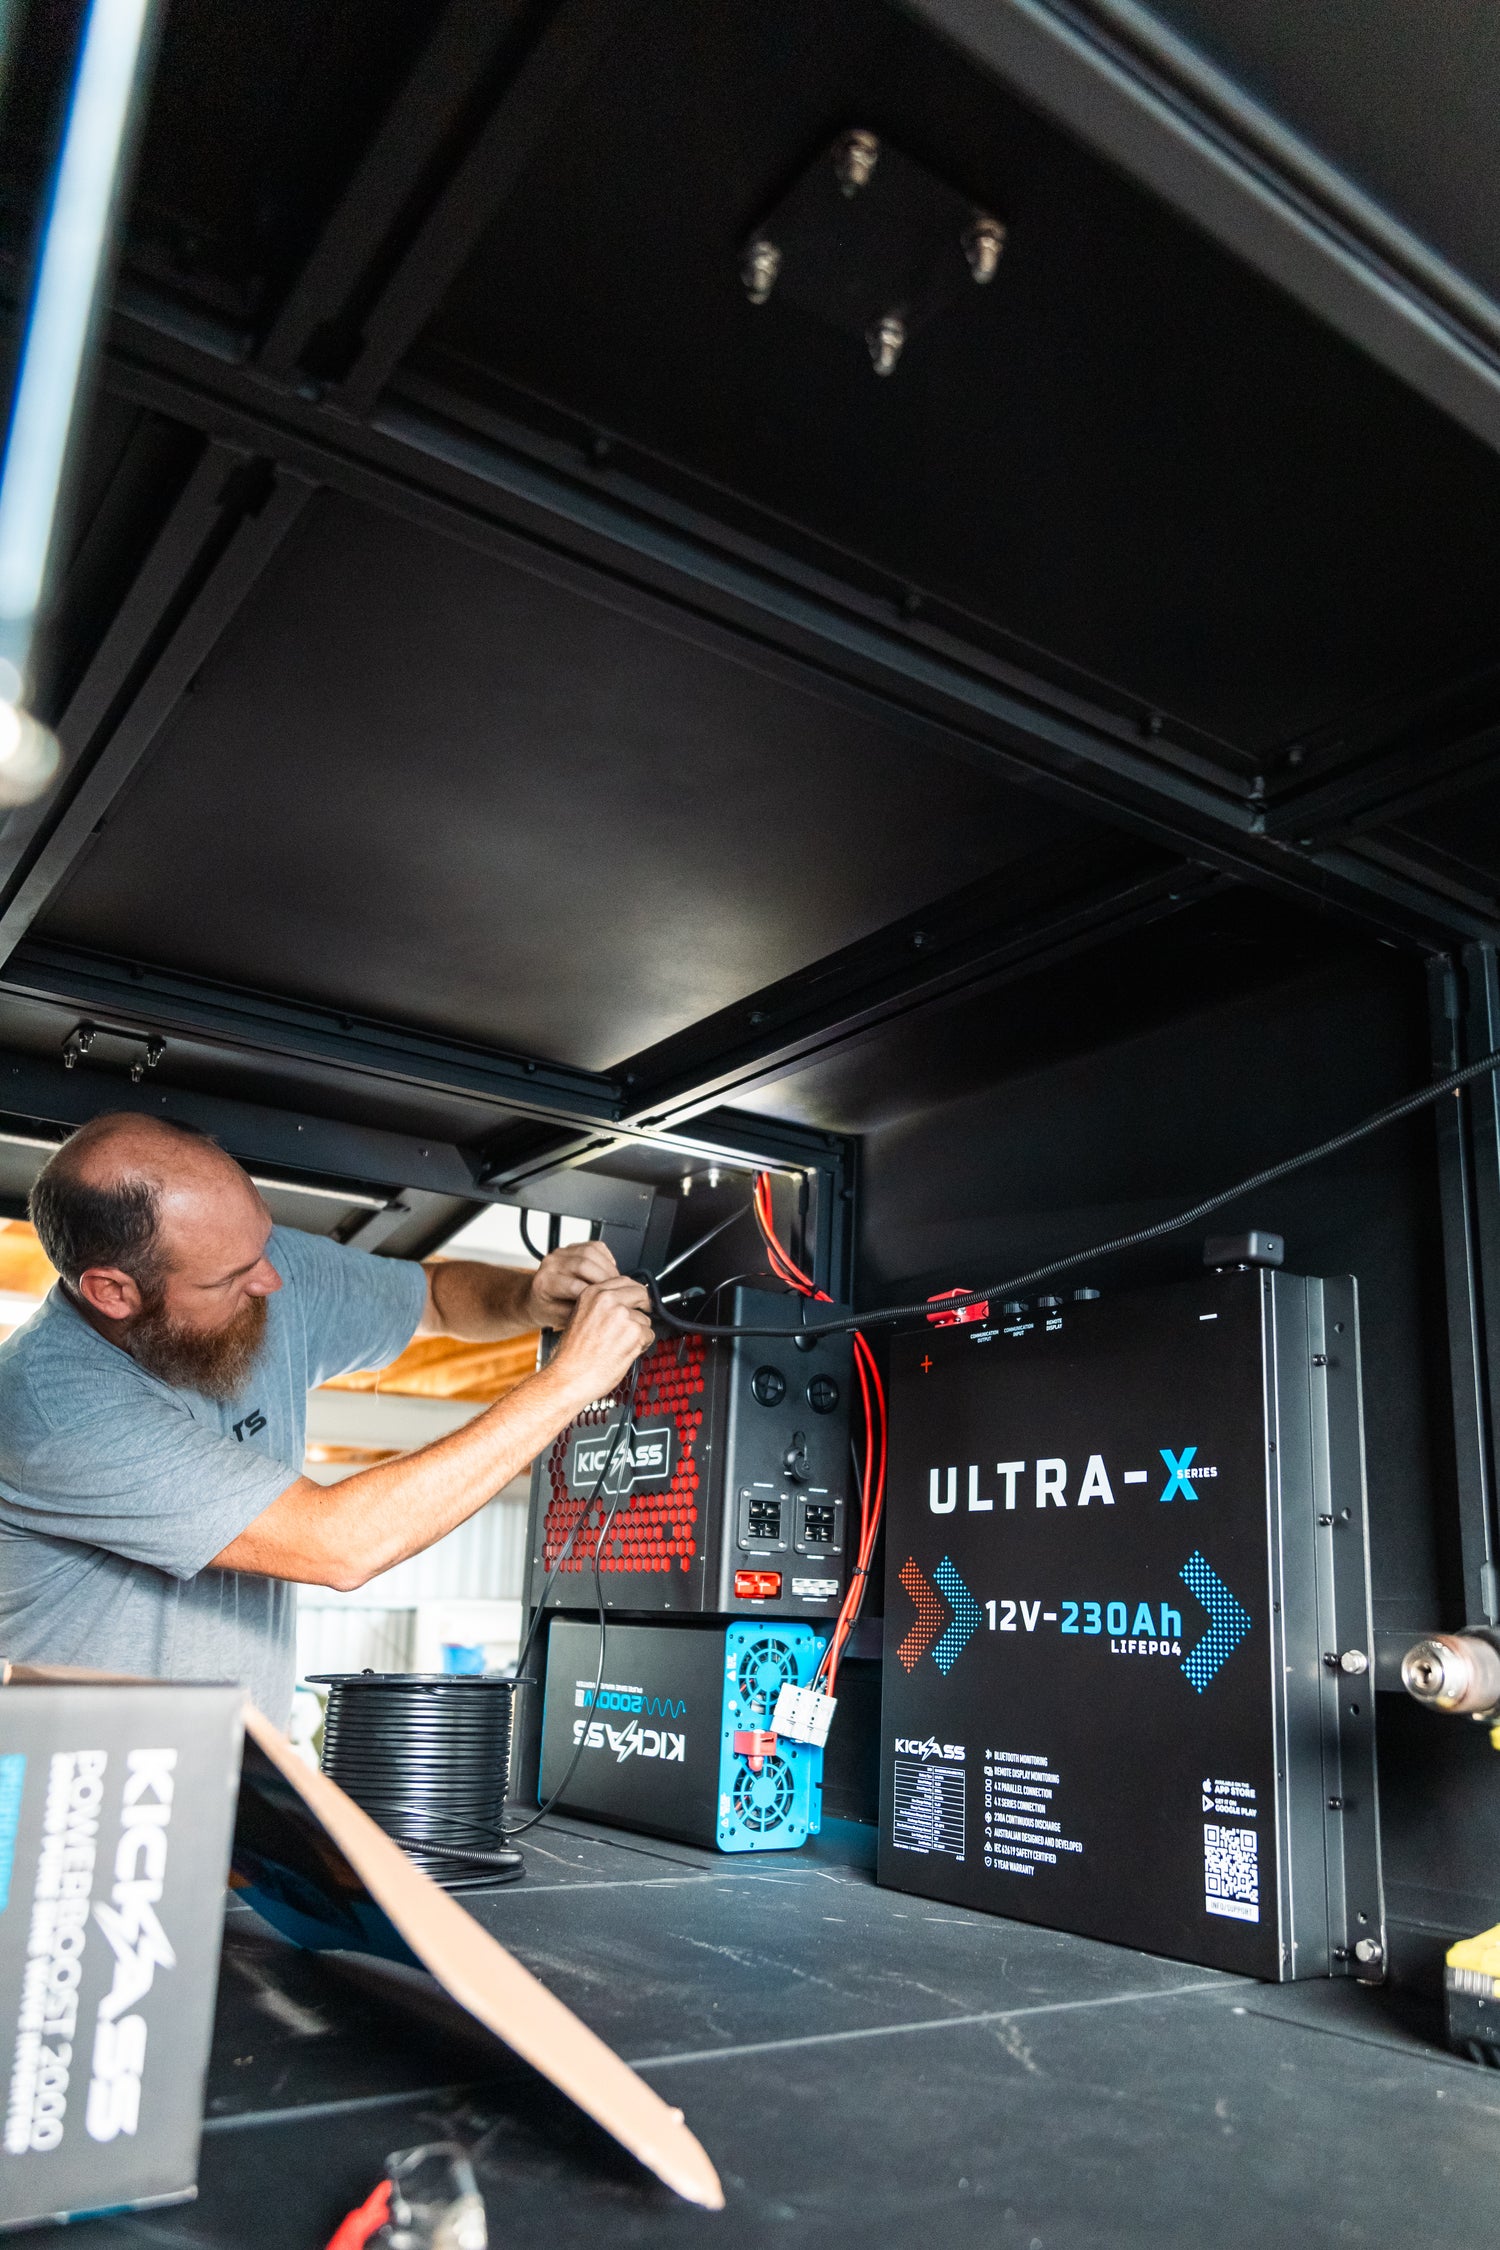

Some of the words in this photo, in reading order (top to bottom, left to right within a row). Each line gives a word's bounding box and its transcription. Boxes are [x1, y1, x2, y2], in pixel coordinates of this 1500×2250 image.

[1176, 1466, 1217, 1479] SERIES
[985, 1600, 1181, 1637] 12V-230Ah
[1111, 1639, 1181, 1656] LIFEPO4
[573, 1720, 685, 1763] KICKASS
[895, 1736, 965, 1760] KICKASS
[994, 1751, 1020, 1763] BLUETOOTH
[1020, 1754, 1048, 1767] MONITORING
[994, 1766, 1012, 1778] REMOTE
[1012, 1769, 1031, 1780] DISPLAY
[1030, 1771, 1059, 1784] MONITORING
[1002, 1783, 1023, 1795] PARALLEL
[1023, 1786, 1052, 1799] CONNECTION
[1214, 1785, 1230, 1795] APP
[1230, 1786, 1256, 1798] STORE
[1002, 1798, 1017, 1809] SERIES
[1017, 1801, 1046, 1814] CONNECTION
[1214, 1804, 1240, 1815] GOOGLE
[1241, 1807, 1257, 1818] PLAY
[1006, 1814, 1035, 1827] CONTINUOUS
[1034, 1819, 1061, 1832] DISCHARGE
[994, 1828, 1021, 1841] AUSTRALIAN
[1022, 1832, 1044, 1845] DESIGNED
[1044, 1836, 1054, 1847] AND
[1055, 1838, 1082, 1852] DEVELOPED
[1016, 1847, 1032, 1860] SAFETY
[1033, 1851, 1056, 1864] CERTIFIED
[998, 1859, 1009, 1870] YEAR
[1009, 1861, 1034, 1876] WARRANTY
[86, 1748, 177, 2141] KICKASS
[29, 2043, 73, 2152] 2000
